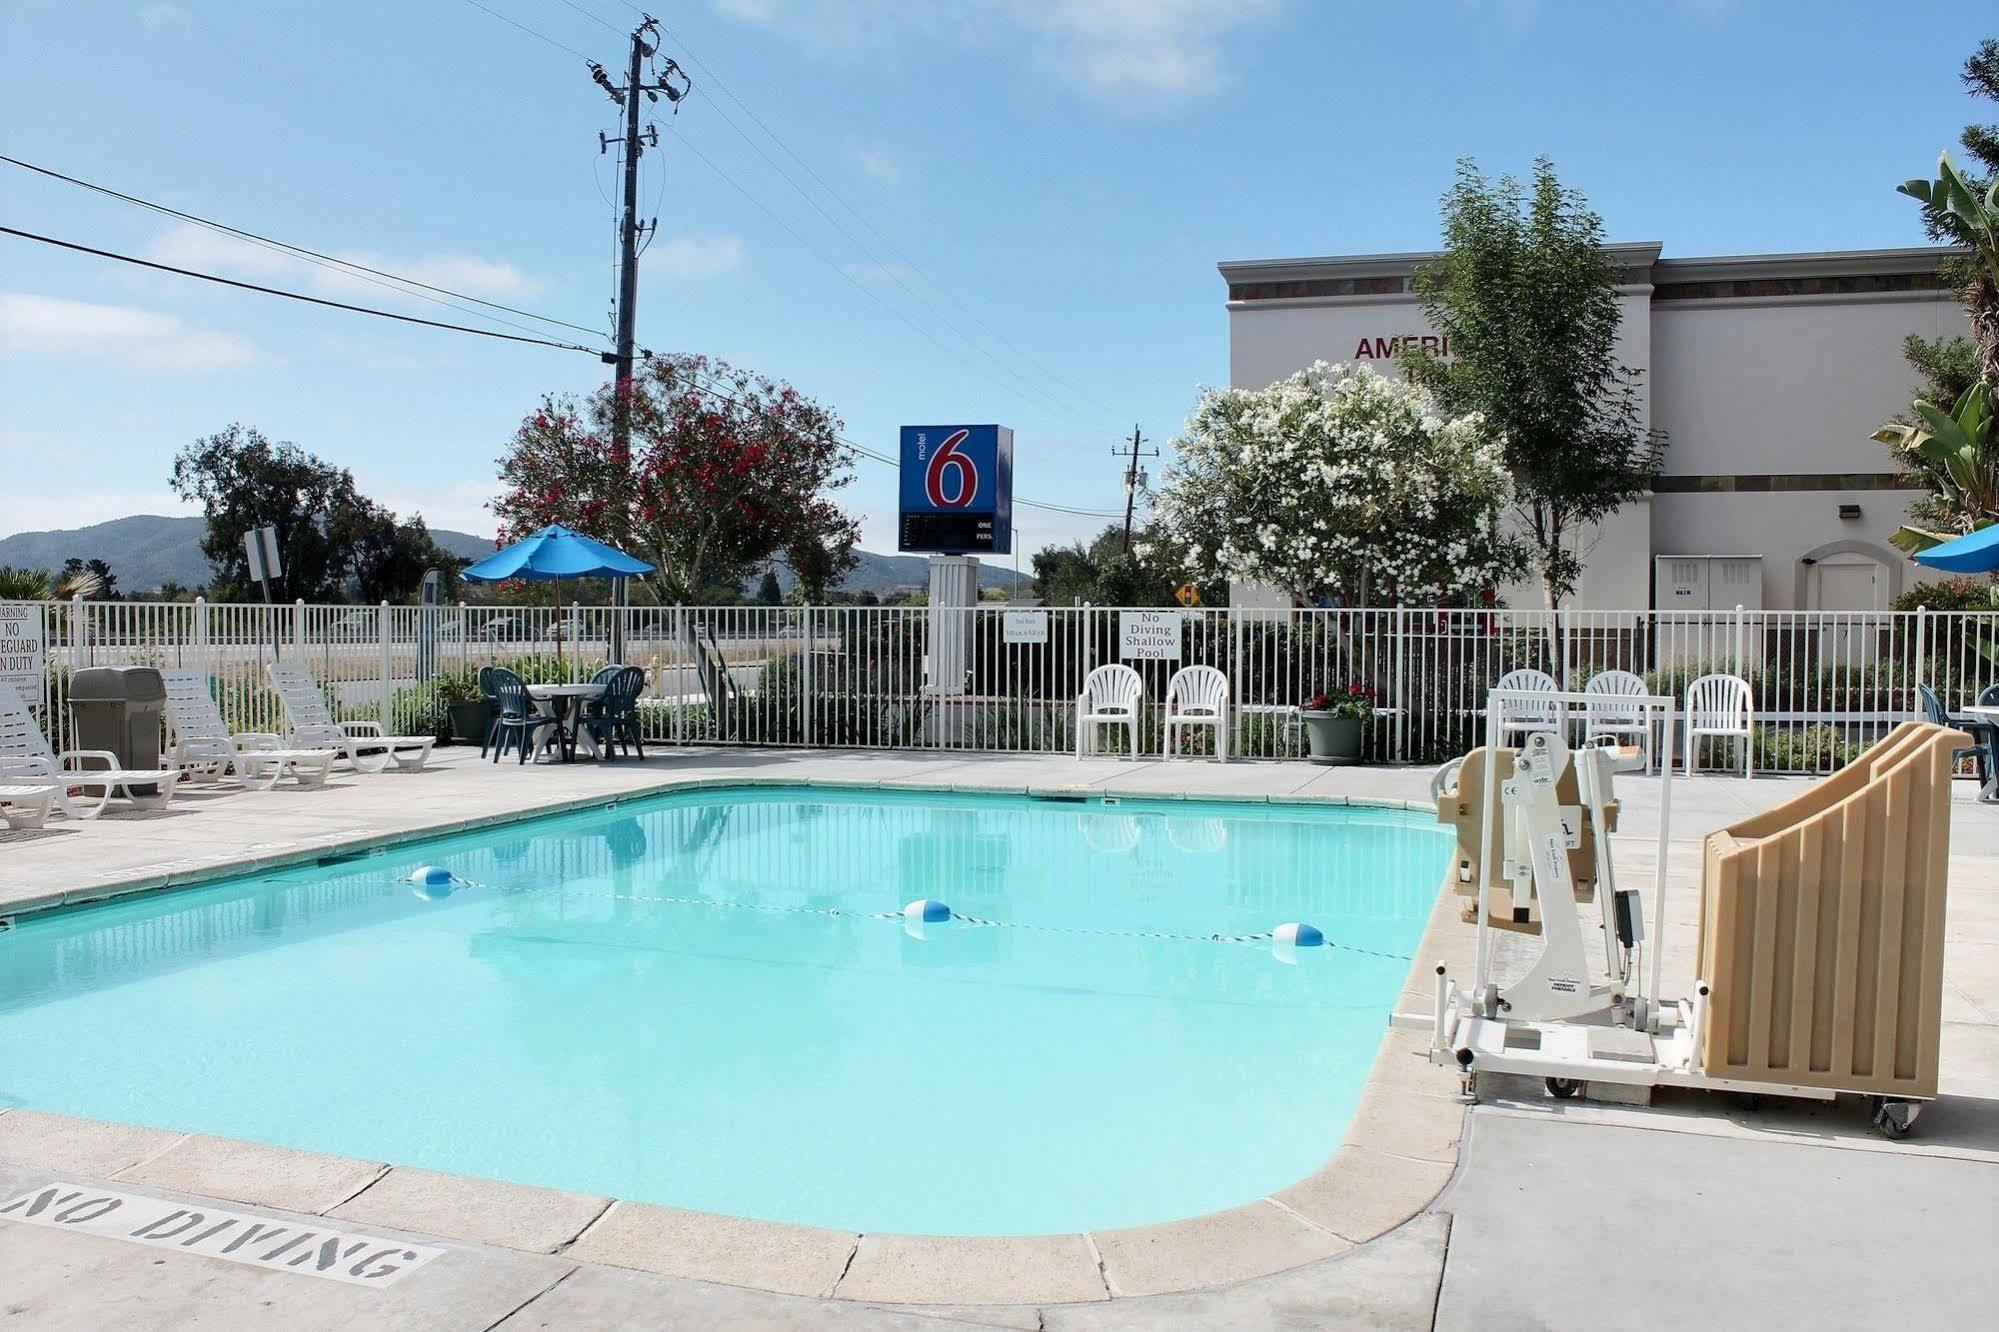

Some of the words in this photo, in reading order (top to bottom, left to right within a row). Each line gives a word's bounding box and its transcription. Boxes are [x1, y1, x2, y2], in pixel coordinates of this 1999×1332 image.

[917, 433, 927, 461] motel
[925, 428, 979, 508] 6
[1142, 613, 1160, 623] No
[5, 622, 20, 637] NO
[1130, 624, 1172, 636] Diving
[1125, 636, 1176, 647] Shallow
[1136, 648, 1165, 658] Pool
[9, 656, 33, 671] DUTY
[0, 1187, 124, 1225] NO
[128, 1209, 419, 1280] DIVING
